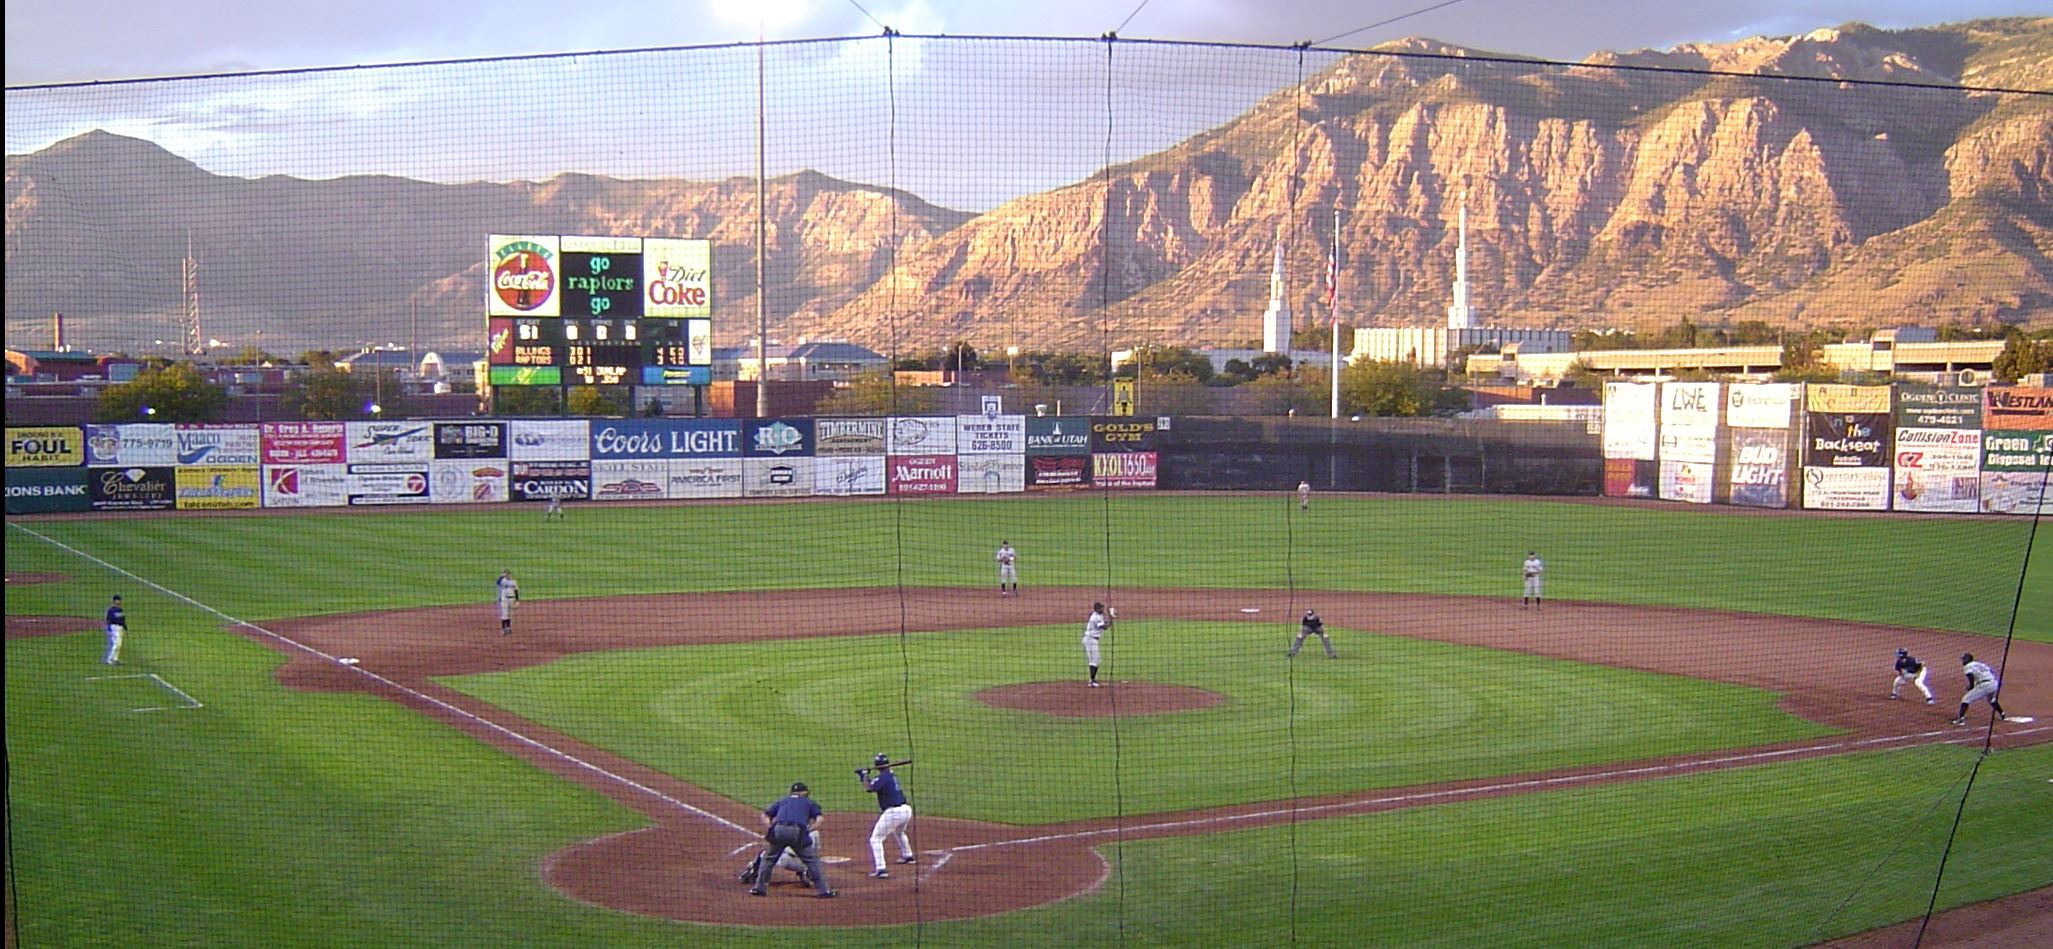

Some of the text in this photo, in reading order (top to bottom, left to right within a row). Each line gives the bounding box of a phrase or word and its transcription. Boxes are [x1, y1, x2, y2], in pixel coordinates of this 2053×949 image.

[590, 257, 610, 274] go
[669, 265, 706, 283] Diet
[568, 277, 634, 295] raptors
[650, 280, 706, 306] Coke
[590, 297, 610, 315] go
[963, 424, 1020, 432] WEBER STATE
[1093, 423, 1154, 432] GOLD'S
[1847, 424, 1871, 438] the
[123, 438, 174, 448] 775-9719
[594, 427, 663, 453] Coors
[671, 430, 738, 452] LIGHT
[1028, 435, 1053, 444] BANK
[1062, 434, 1088, 444] UTAH
[1105, 433, 1142, 442] GYM
[1985, 436, 2029, 451] Green
[11, 439, 72, 455] FOUL
[1815, 438, 1880, 453] Backseat
[206, 455, 258, 464] OGDEN
[1738, 446, 1779, 465] BUD
[1987, 453, 2036, 466] Disposal
[671, 474, 741, 483] AMERICA FIRST
[892, 465, 952, 482] Marriott
[1731, 468, 1783, 485] LIGHT
[44, 484, 88, 496] BANK
[101, 471, 167, 495] Chevalier
[523, 480, 588, 494] CARDON
